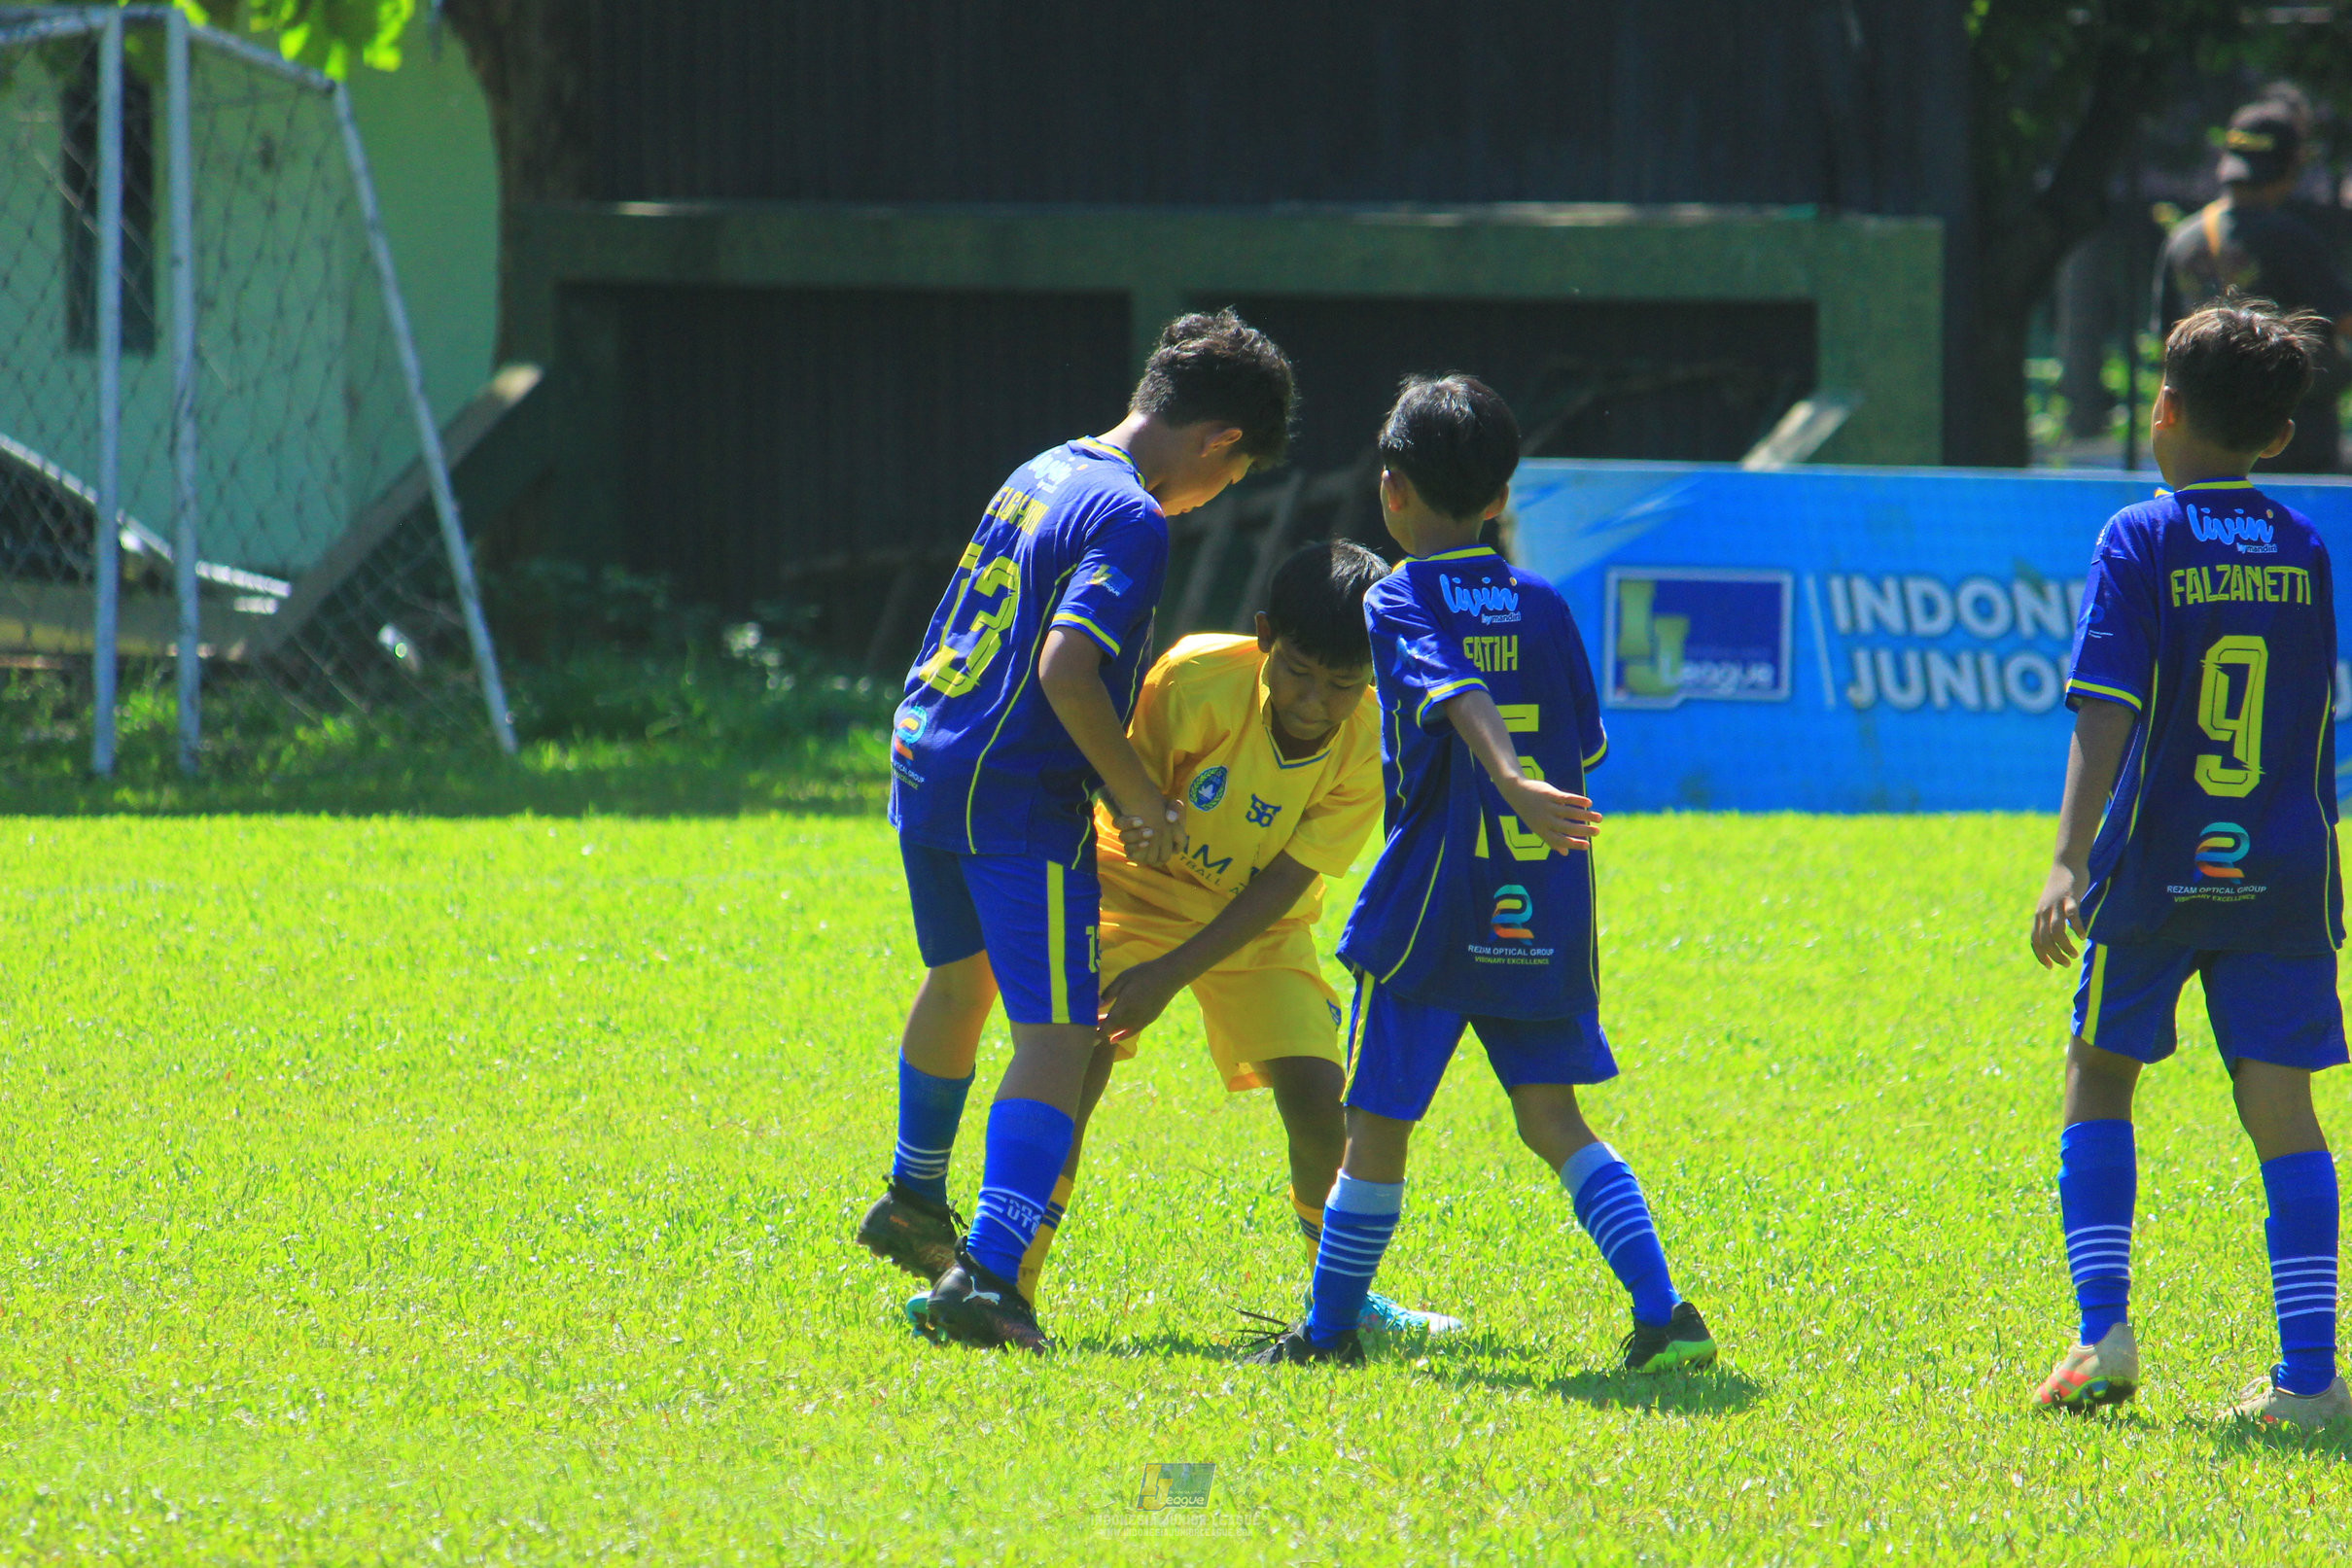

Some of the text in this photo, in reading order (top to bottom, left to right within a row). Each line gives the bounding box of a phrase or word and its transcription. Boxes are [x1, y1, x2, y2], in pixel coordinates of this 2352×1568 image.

[2170, 564, 2311, 607] FALZANETTI
[1462, 634, 1518, 672] FATIH
[1659, 652, 1774, 695] League
[2194, 635, 2268, 798] 9
[1086, 925, 1100, 973] 1
[1492, 948, 1528, 957] OPTICAL
[1529, 948, 1554, 957] GROUP
